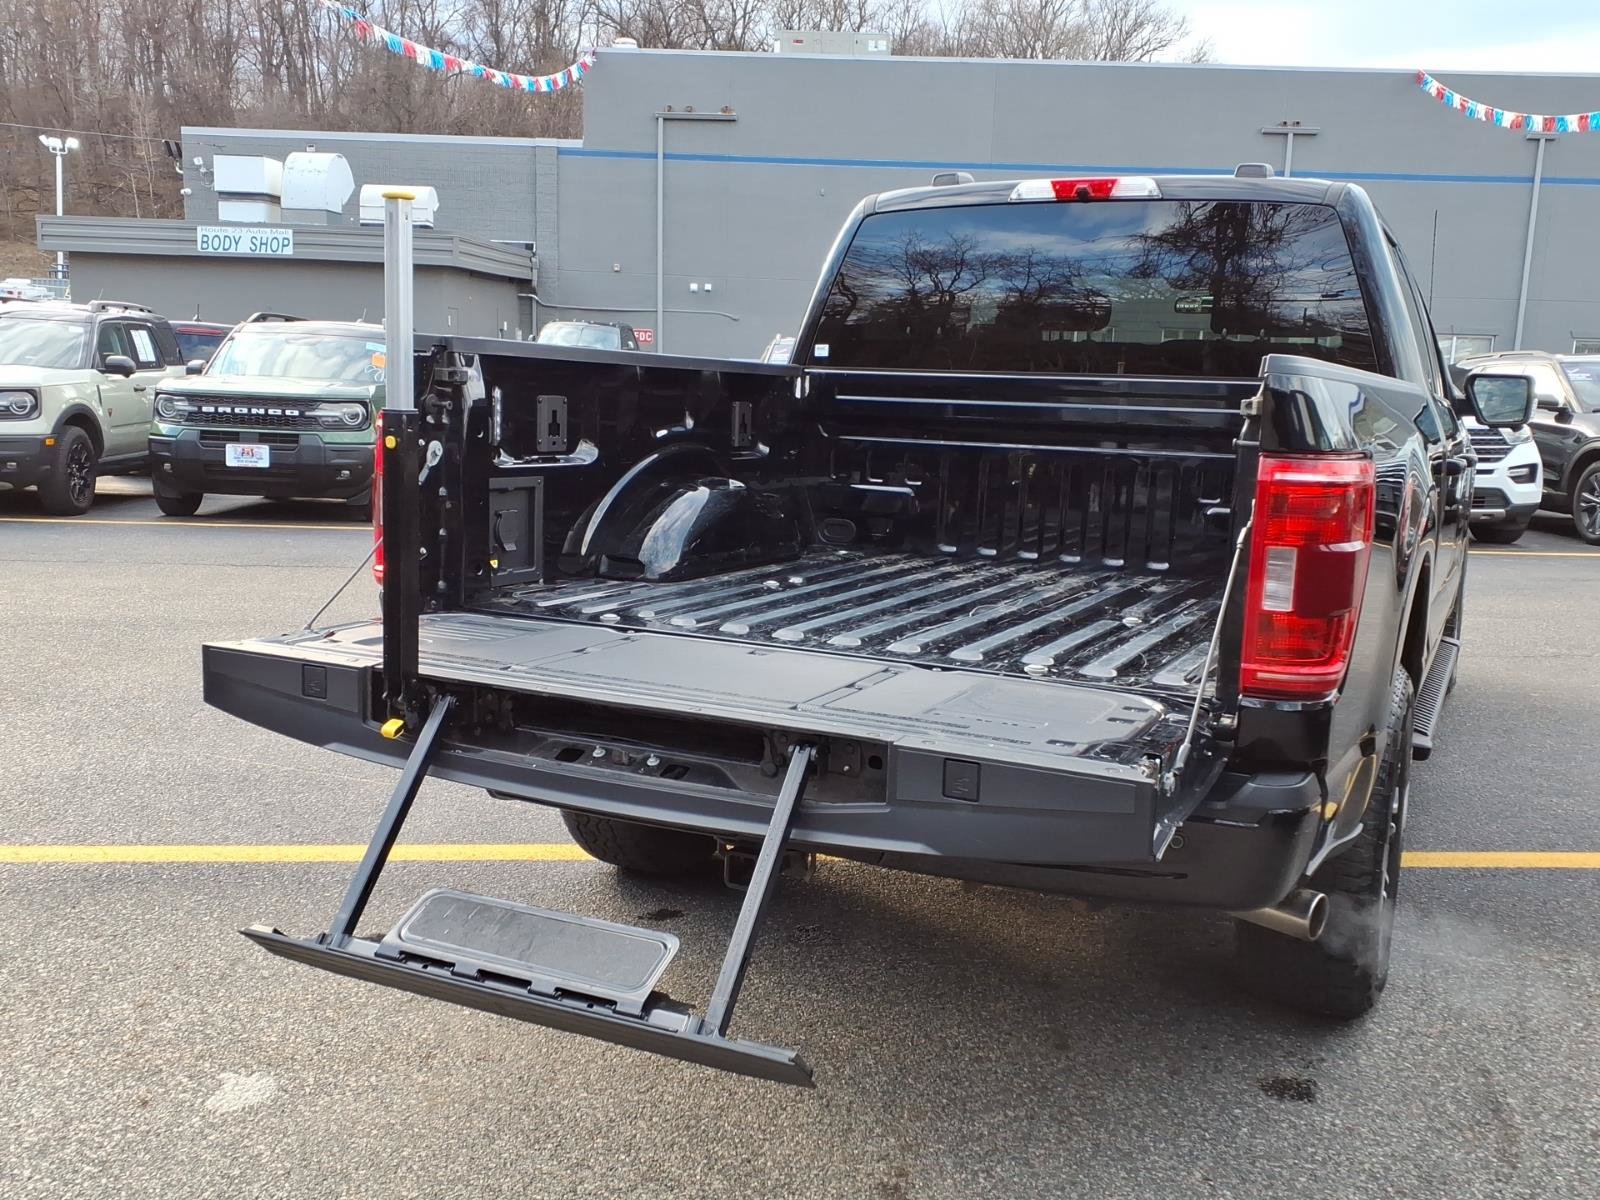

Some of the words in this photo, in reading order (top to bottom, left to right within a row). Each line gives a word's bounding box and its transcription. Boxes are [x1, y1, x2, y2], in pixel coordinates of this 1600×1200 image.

[200, 234, 242, 251] BODY
[249, 235, 291, 253] SHOP
[201, 406, 300, 416] BRONCO
